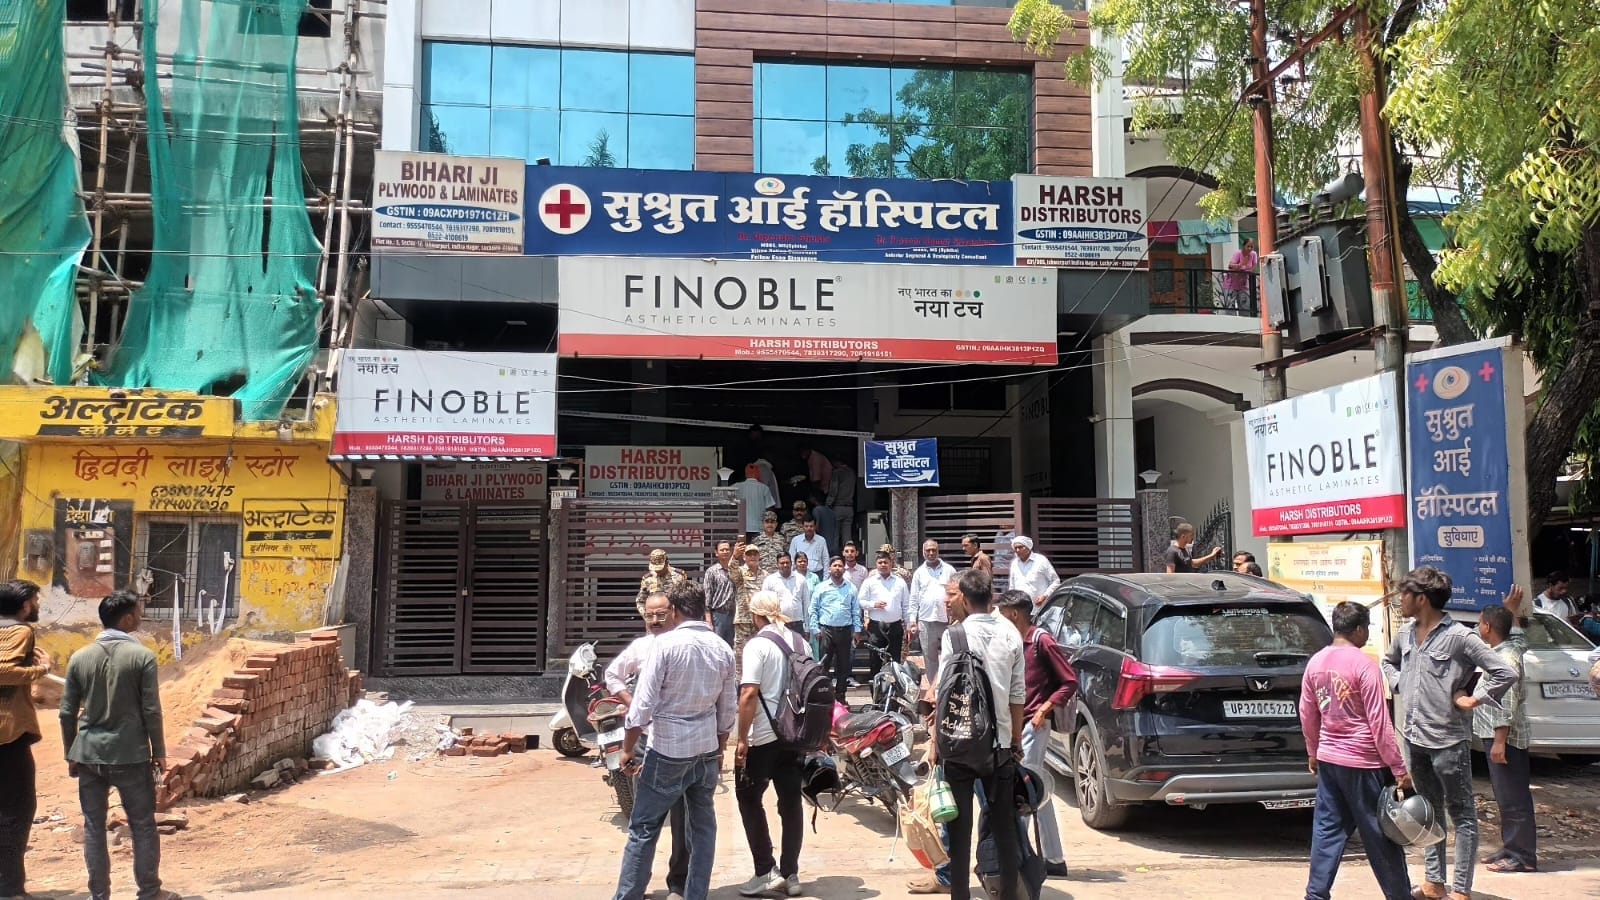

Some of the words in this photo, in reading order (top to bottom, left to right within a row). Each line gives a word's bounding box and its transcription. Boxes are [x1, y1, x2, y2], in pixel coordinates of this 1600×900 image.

[401, 160, 472, 184] BIHARI
[480, 167, 498, 185] JI
[379, 182, 436, 199] PLYWOOD
[440, 185, 448, 200] &
[452, 186, 518, 204] LAMINATES
[1040, 184, 1123, 206] HARSH
[386, 206, 415, 216] GSTIN
[602, 192, 718, 234] सुश्रुत
[817, 188, 1000, 232] हॉस्पिटल
[1021, 206, 1142, 224] DISTRIBUTORS
[1036, 230, 1056, 238] GSTIN
[898, 288, 912, 298] नए
[914, 288, 937, 298] भारत
[940, 288, 952, 298] का
[914, 300, 950, 318] नया
[953, 301, 984, 319] टच
[624, 314, 718, 325] ASTHETIC
[732, 316, 837, 327] LAMINATES
[750, 339, 790, 348] HARSH
[794, 339, 878, 350] DISTRIBUTORS
[356, 362, 378, 374] नया
[380, 364, 400, 374] टच
[453, 417, 531, 425] LAMINATES
[1424, 404, 1475, 442] सुश्रुत
[387, 435, 424, 444] HARSH
[428, 435, 505, 445] DISTRIBUTORS
[884, 440, 917, 455] सुश्रुत
[72, 447, 153, 481] द्विवेदी
[244, 448, 300, 478] स्टोर
[621, 449, 682, 464] HARSH
[872, 456, 890, 470] आई
[1433, 436, 1472, 477] आई
[426, 474, 468, 487] BIHARI
[471, 474, 482, 486] JI
[486, 473, 543, 486] PLYWOOD
[590, 465, 711, 480] DISTRIBUTORS
[1270, 484, 1312, 496] ASTHETIC
[1320, 475, 1380, 491] LAMINATES
[444, 488, 454, 500] &
[458, 487, 525, 500] LAMINATES
[1415, 484, 1498, 520] हॉस्पिटल
[244, 503, 336, 528] अल्ट्राटेक
[1280, 511, 1303, 522] HARSH
[1305, 504, 1361, 519] DISTRIBUTORS
